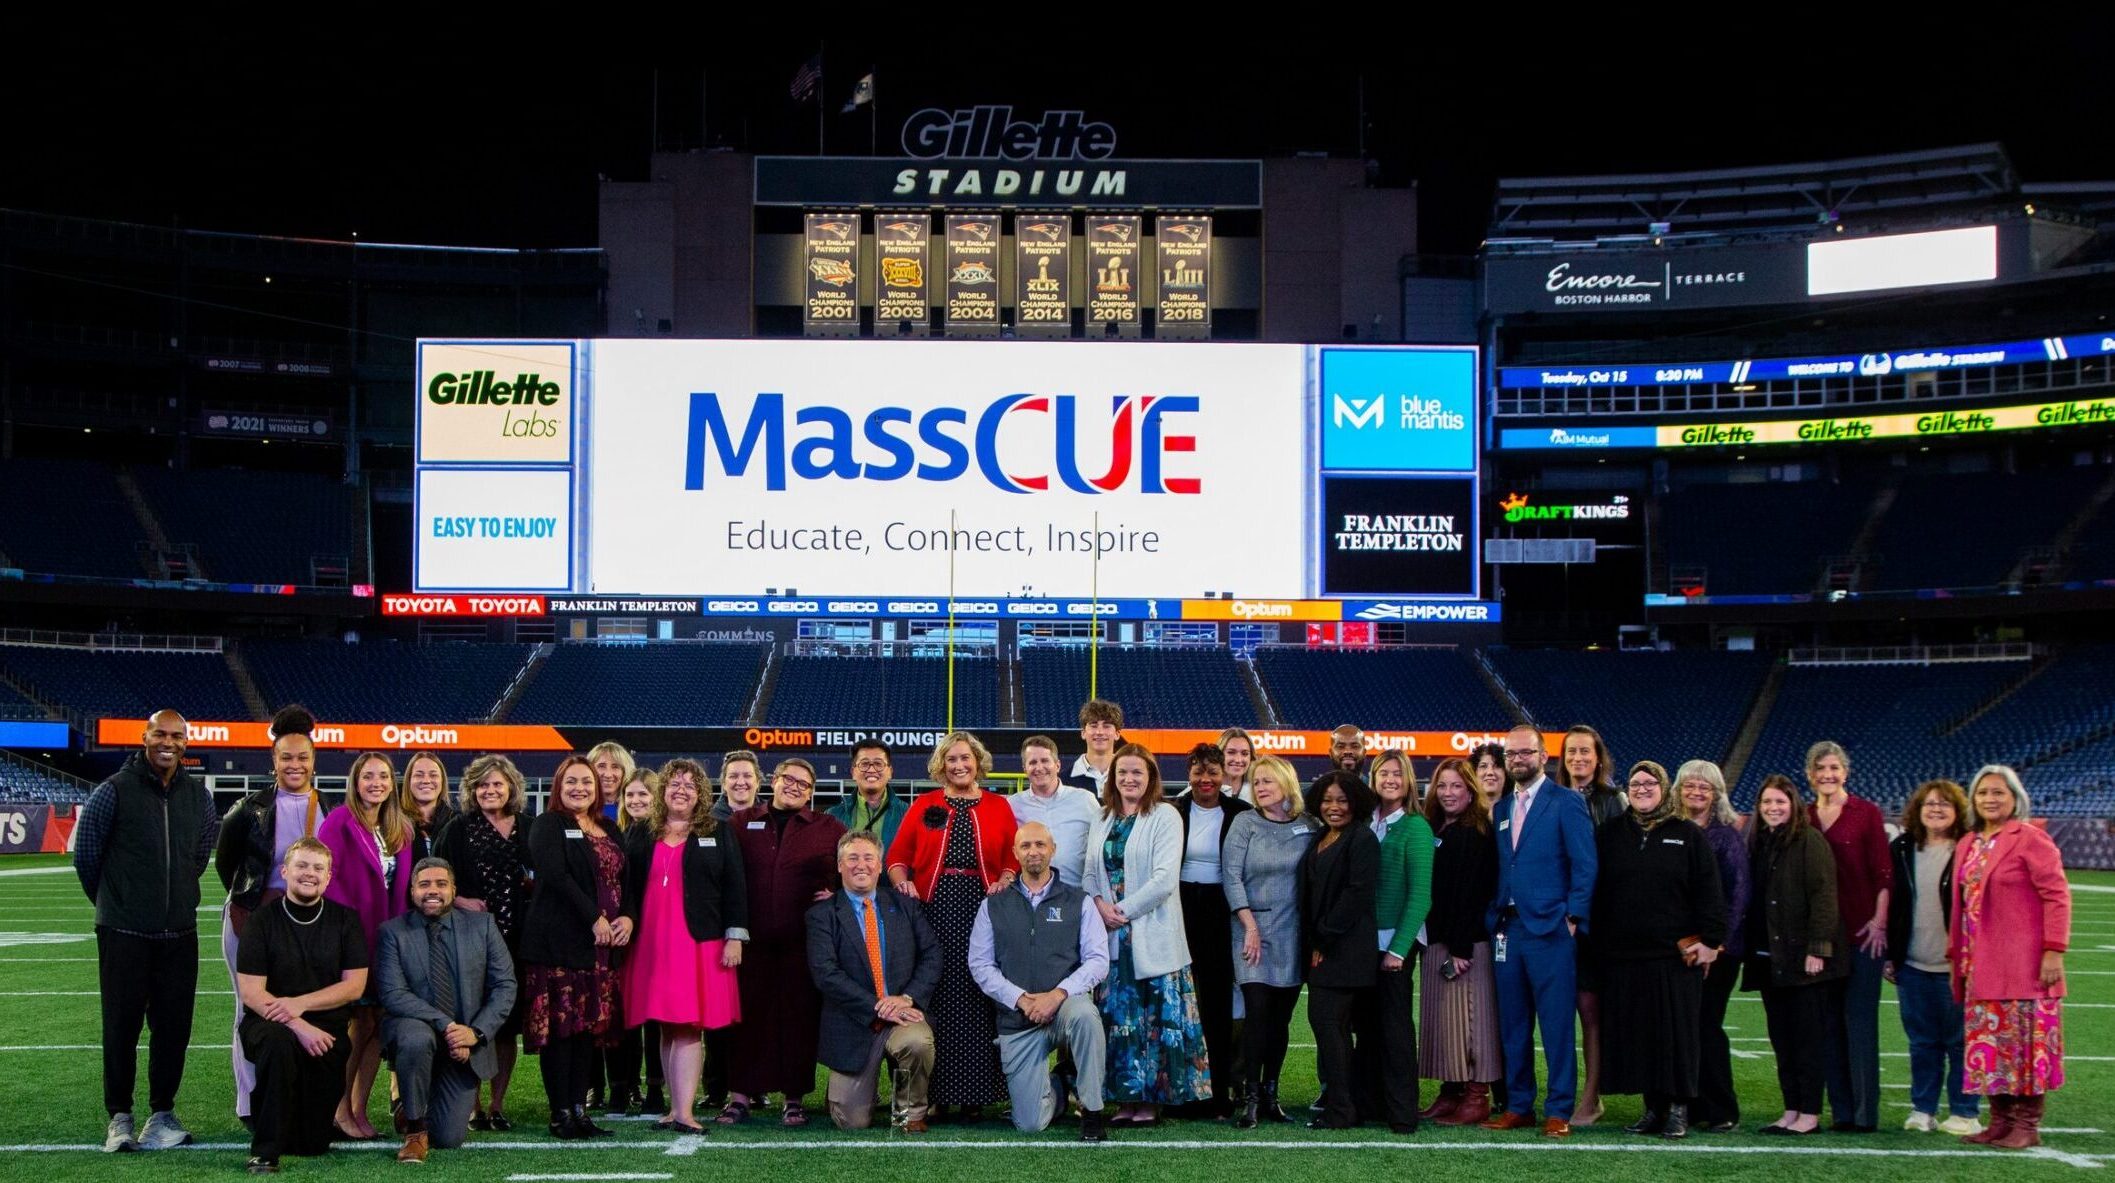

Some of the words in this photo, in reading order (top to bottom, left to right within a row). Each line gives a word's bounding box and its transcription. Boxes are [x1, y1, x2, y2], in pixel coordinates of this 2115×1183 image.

[902, 104, 1117, 160] Gillette
[892, 168, 1128, 195] STADIUM
[1546, 263, 1661, 291] Encore
[1675, 272, 1745, 285] TERRACE
[1026, 282, 1060, 291] XLIX
[809, 298, 854, 307] CHAMPIONS
[879, 299, 925, 307] CHAMPIONS
[950, 299, 996, 307] CHAMPIONS
[1020, 300, 1066, 308] CHAMPIONS
[1091, 300, 1136, 308] CHAMPIONS
[1161, 301, 1206, 309] CHAMPIONS
[1555, 294, 1601, 304] BOSTON
[1604, 293, 1651, 303] HARBOR
[812, 307, 852, 318] 2001
[880, 307, 924, 318] 2003
[950, 308, 994, 319] 2004
[1023, 309, 1063, 320] 2014
[1094, 309, 1133, 320] 2016
[1163, 309, 1203, 320] 2018
[1541, 371, 1588, 386] Tuesday,
[1590, 372, 1609, 382] Oct
[1613, 371, 1627, 382] 15
[1684, 368, 1703, 381] PM
[428, 370, 561, 406] Gillette
[1401, 394, 1441, 413] blue
[2037, 401, 2115, 423] Gillette
[231, 416, 265, 431] 2021
[268, 421, 310, 434] WINNERS
[502, 410, 558, 438] Labs
[1401, 411, 1465, 430] mantis
[1916, 410, 1995, 432] Gillette
[1681, 425, 1755, 444] Gillette
[1797, 419, 1873, 439] Gillette
[685, 392, 1202, 495] MassCUE
[1576, 434, 1610, 444] Mutual
[1504, 505, 1628, 522] DRAFTKINGS
[434, 517, 477, 538] EASY
[479, 517, 501, 538] TO
[504, 517, 556, 539] ENJOY
[1344, 515, 1454, 532] FRANKLIN
[728, 520, 870, 555] Educate,
[884, 522, 1033, 557] Connect,
[1048, 524, 1159, 560] Inspire
[1335, 533, 1463, 551] TEMPLETON
[385, 598, 457, 613] TOYOTA
[468, 598, 541, 613] TOYOTA
[551, 600, 617, 611] FRANKLIN
[620, 600, 696, 612] TEMPLETON
[708, 601, 758, 612] GEICO
[768, 601, 818, 612] GEICO
[828, 602, 879, 612] GEICO
[888, 602, 938, 613] GEICO
[948, 602, 998, 613] GEICO
[1007, 603, 1058, 614] GEICO
[1067, 603, 1118, 614] GEICO
[1231, 600, 1292, 617] Optum
[1402, 605, 1488, 620] EMPOWER
[186, 722, 229, 741] tum
[381, 725, 457, 748] Optum
[745, 728, 811, 748] Optum
[816, 732, 867, 746] FIELD
[1251, 732, 1306, 750] ptum
[1364, 733, 1416, 751] ptum
